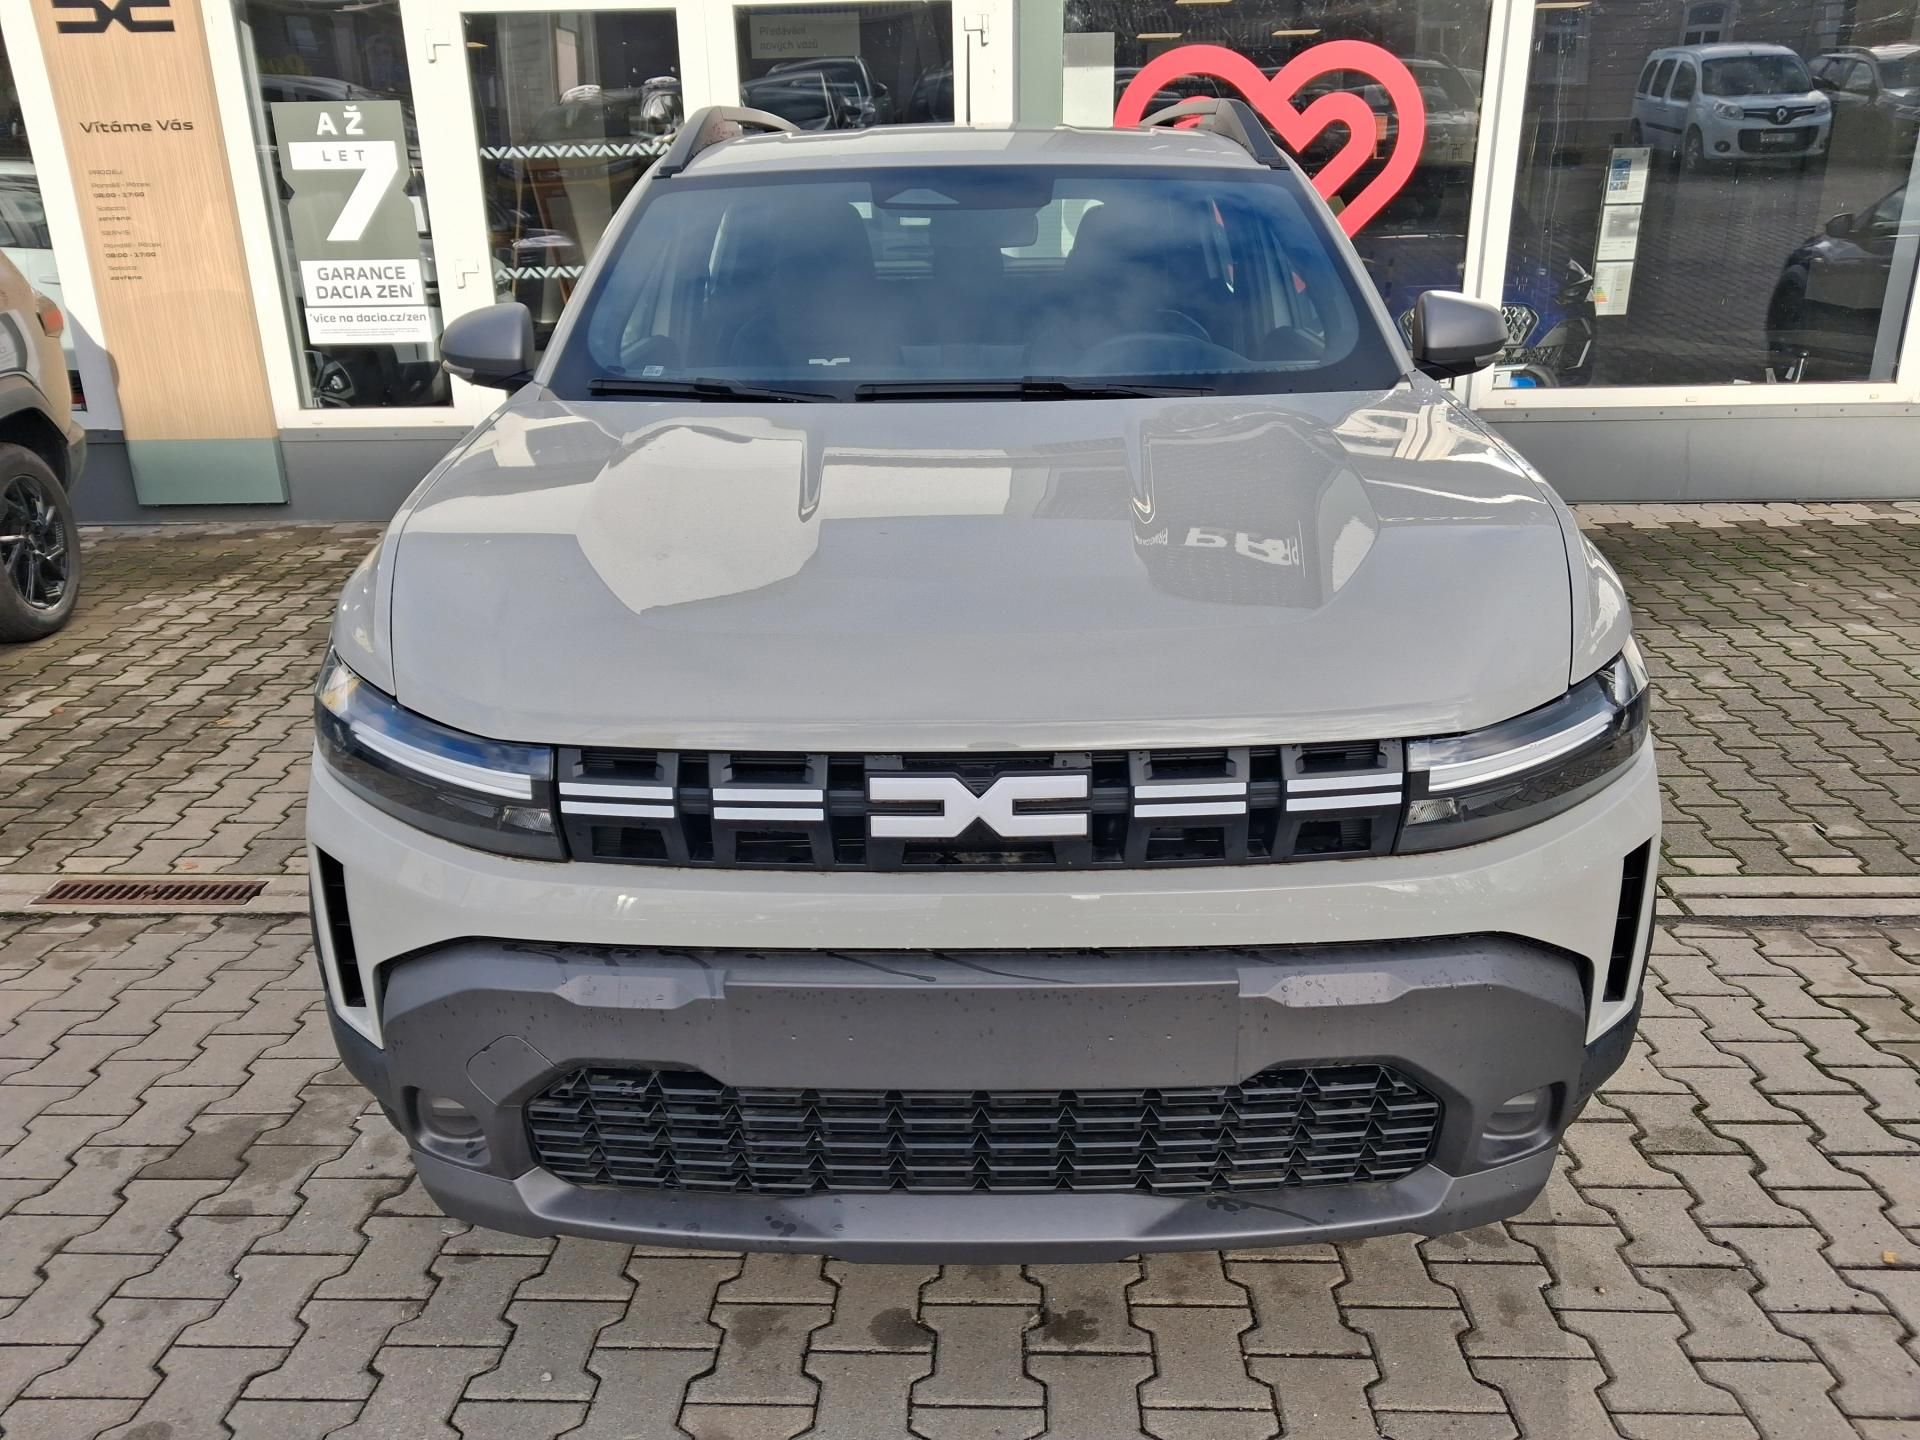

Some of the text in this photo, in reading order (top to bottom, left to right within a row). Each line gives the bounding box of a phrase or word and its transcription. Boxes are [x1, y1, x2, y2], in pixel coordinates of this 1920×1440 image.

[79, 118, 194, 133] Vítáme Vás
[316, 105, 364, 136] AŽ
[322, 149, 365, 162] LET
[288, 141, 398, 241] 7
[317, 266, 407, 281] GARANCE
[315, 285, 373, 300] DACIA
[340, 314, 354, 323] na
[356, 312, 427, 322] dacia.cz/zen
